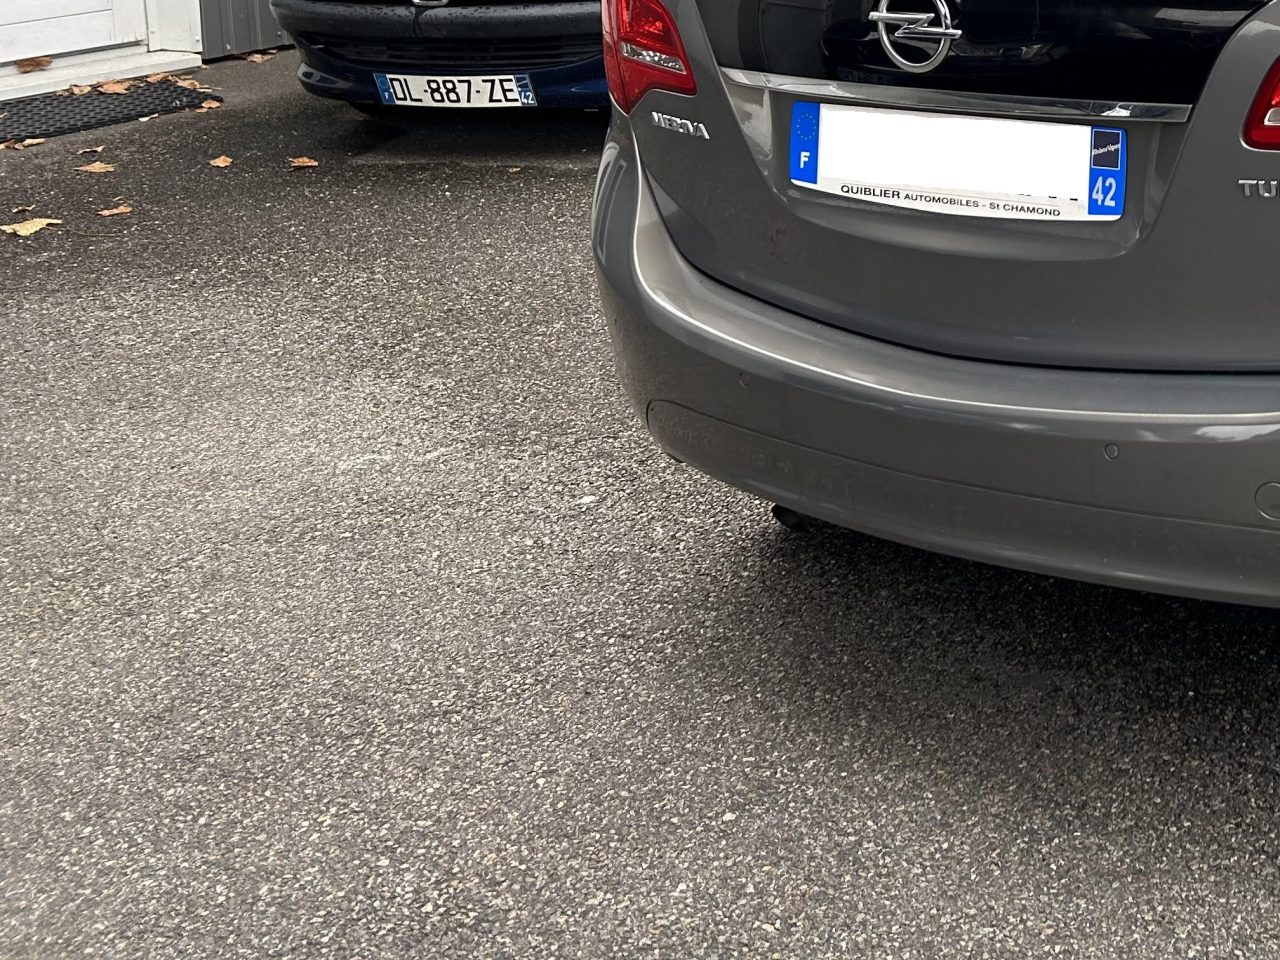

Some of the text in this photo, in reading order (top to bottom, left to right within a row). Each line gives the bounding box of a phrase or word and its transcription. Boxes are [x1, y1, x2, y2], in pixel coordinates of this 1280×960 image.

[389, 77, 520, 104] DL-887-ZE
[521, 91, 535, 104] 42
[799, 151, 811, 169] F
[840, 184, 901, 200] QUIBLIER
[903, 192, 980, 208] AUTOMOBILES
[1002, 203, 1061, 217] CHAMOND
[1091, 175, 1117, 207] 42
